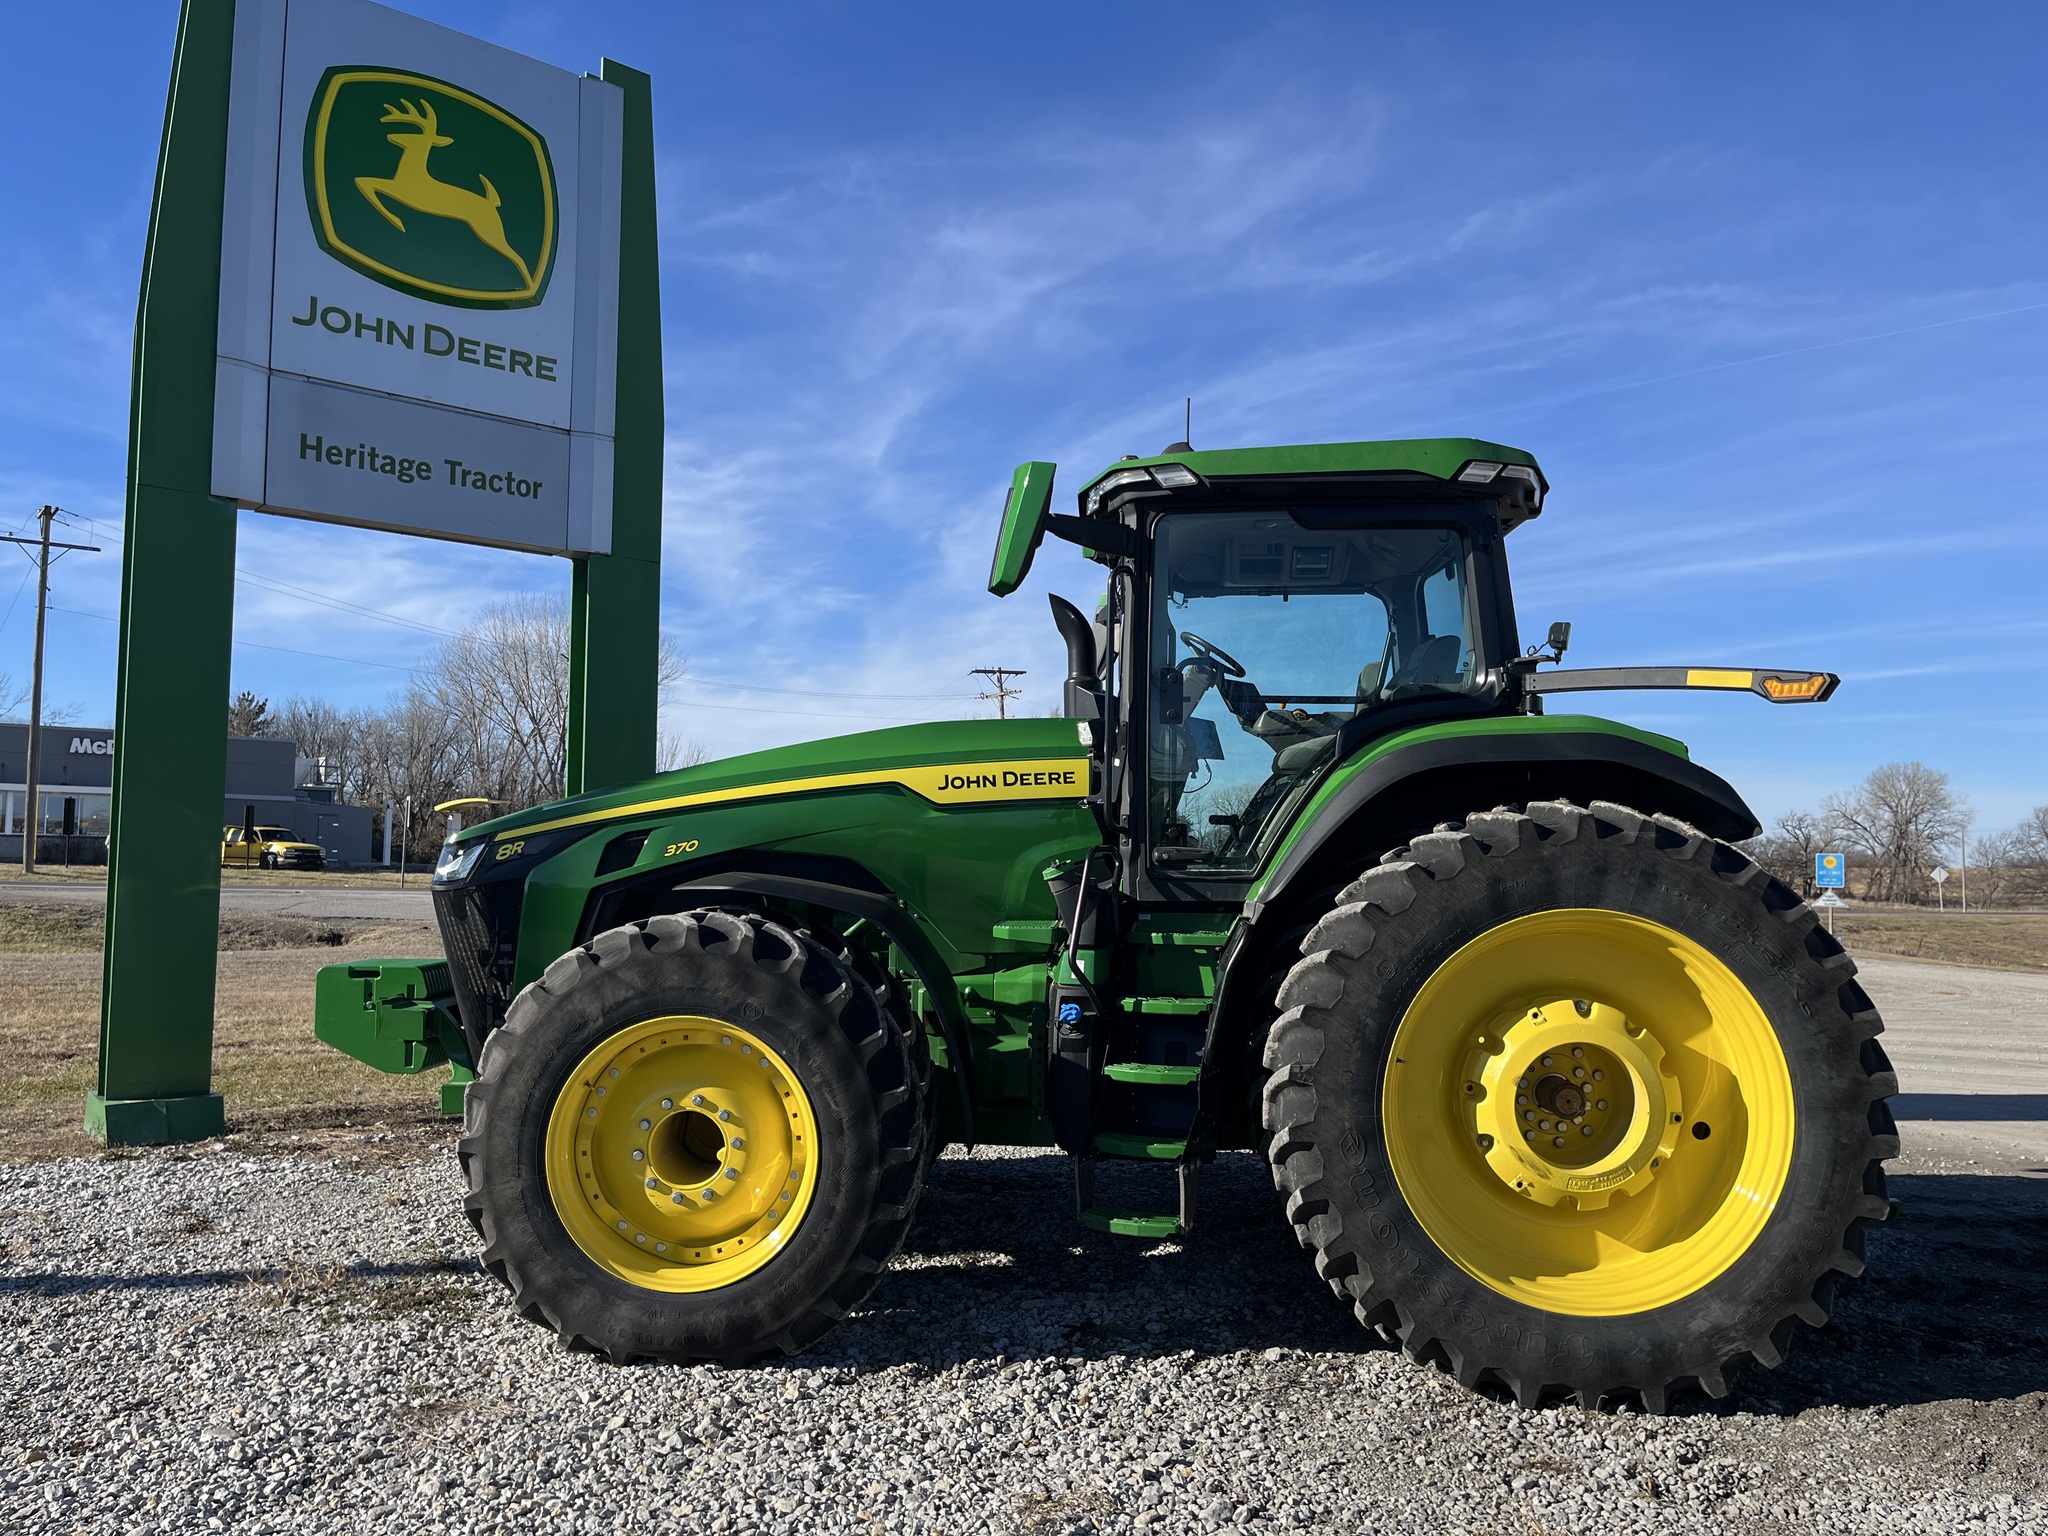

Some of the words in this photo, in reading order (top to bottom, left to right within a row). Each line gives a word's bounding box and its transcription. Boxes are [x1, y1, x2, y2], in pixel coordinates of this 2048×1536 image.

[292, 296, 415, 350] JOHN
[424, 323, 558, 383] DEERE
[299, 432, 432, 484] Heritage
[444, 459, 543, 500] Tractor
[937, 774, 997, 791] JOHN
[1003, 771, 1076, 787] DEERE
[495, 840, 525, 861] 8R
[663, 839, 699, 858] 370
